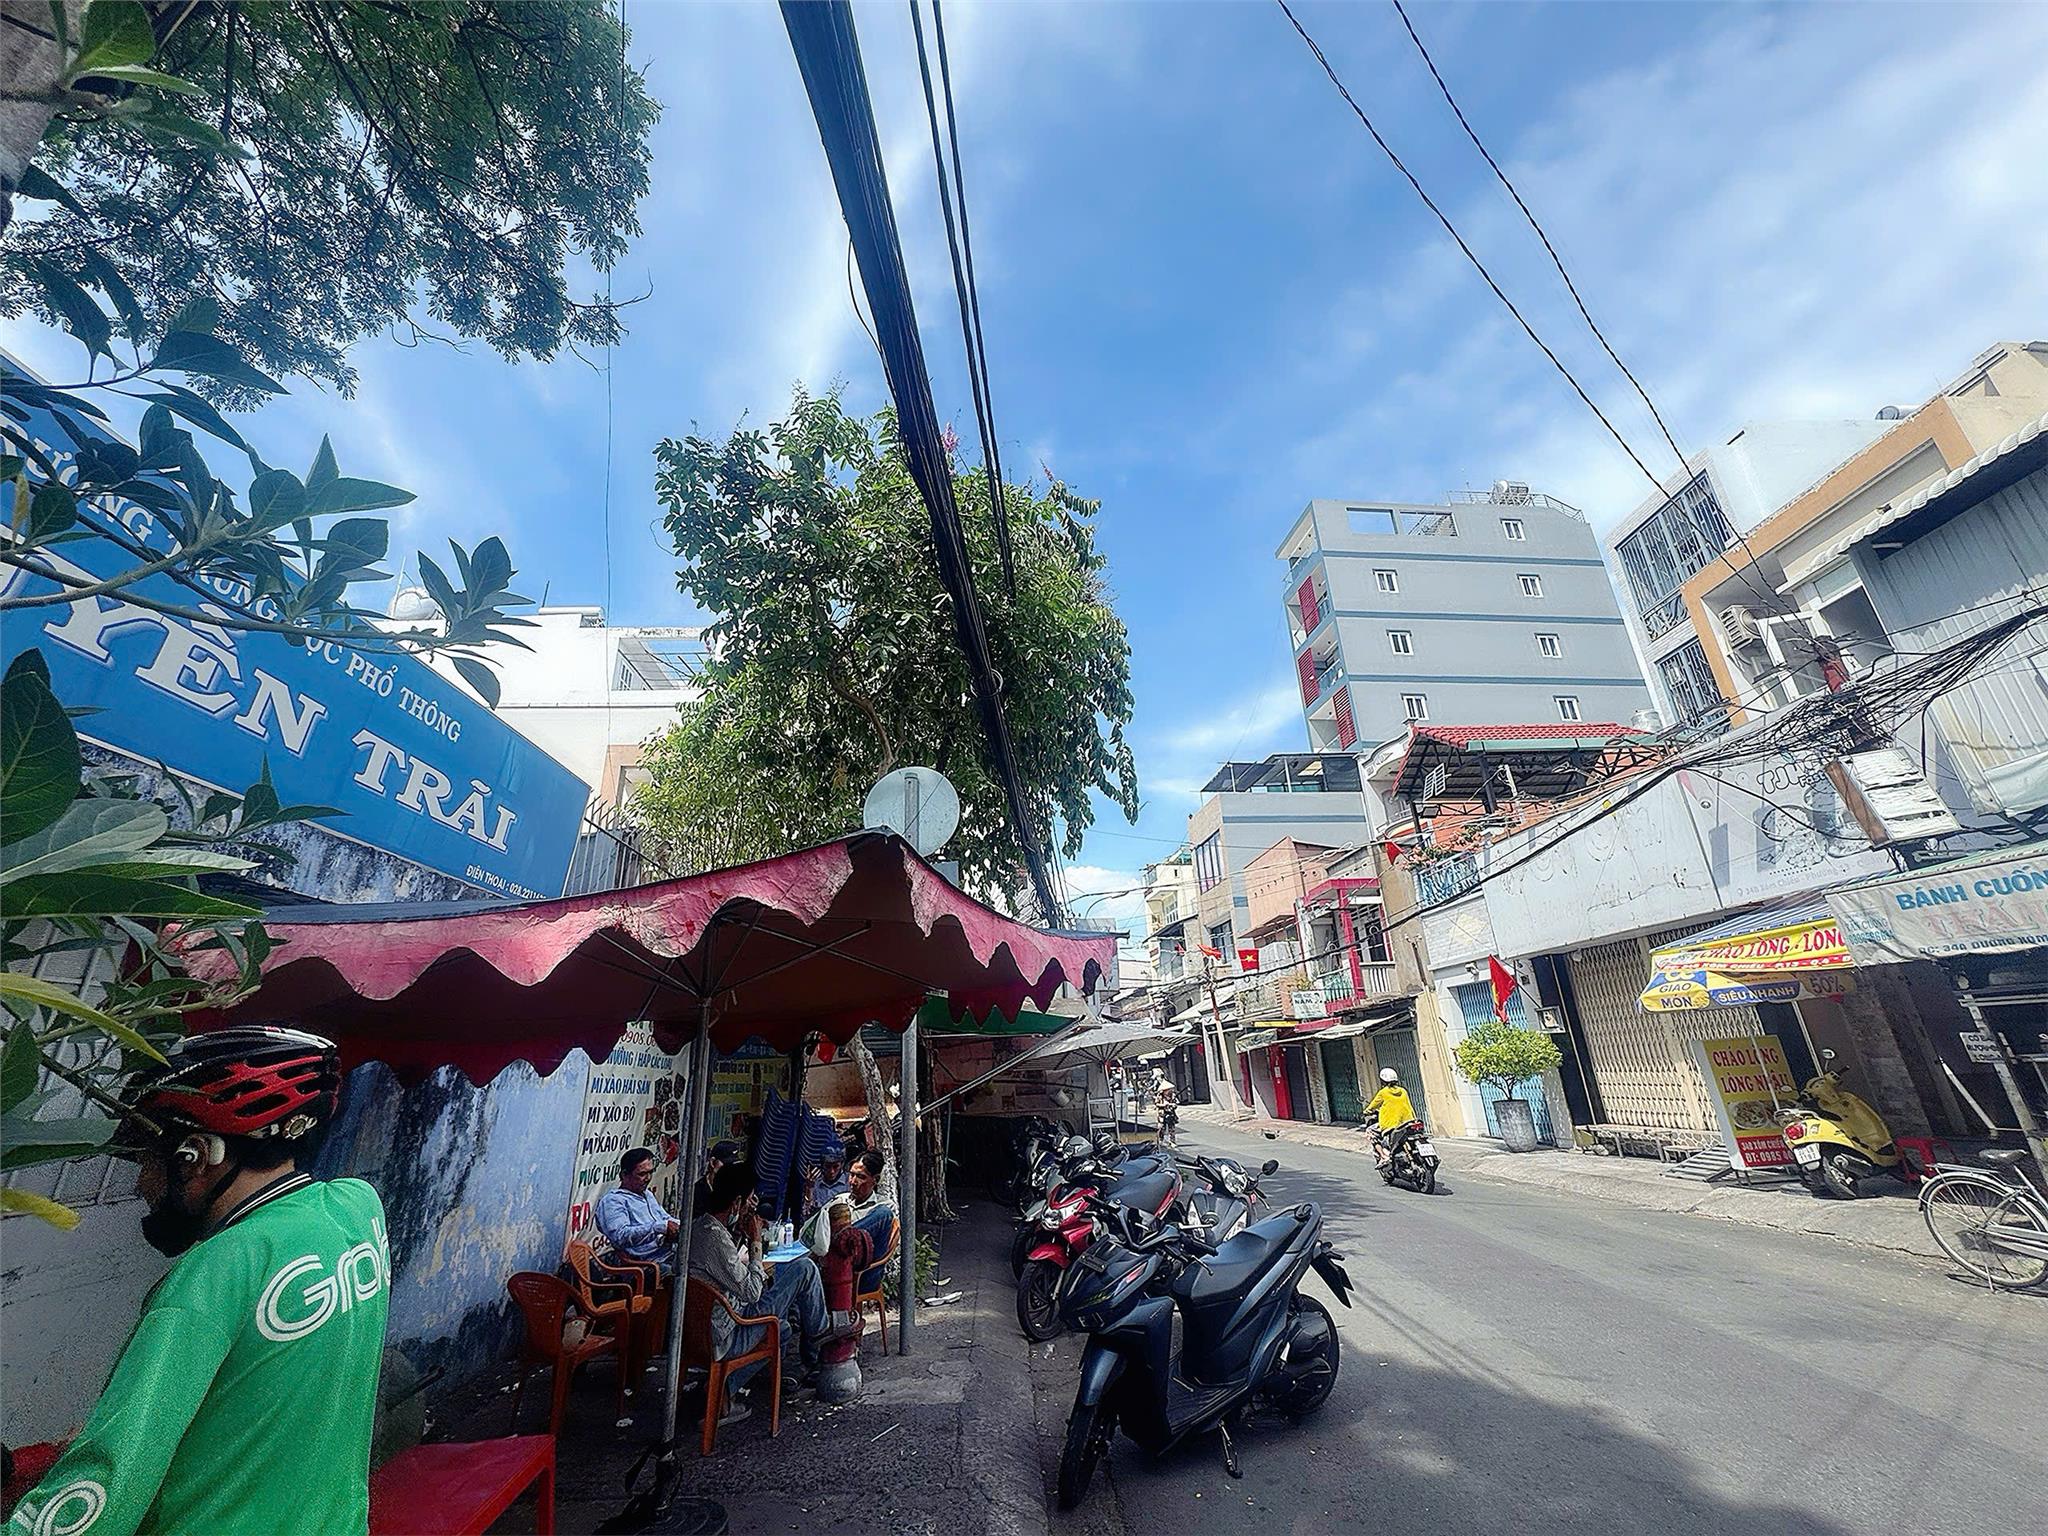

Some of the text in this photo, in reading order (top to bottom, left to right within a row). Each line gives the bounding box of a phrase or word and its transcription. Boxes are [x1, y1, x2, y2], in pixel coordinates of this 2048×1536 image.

[345, 652, 399, 698] PHỔ
[398, 686, 462, 744] THÔNG
[351, 728, 518, 855] TRÃI
[466, 864, 485, 882] ĐIỆN
[484, 871, 506, 892] THOẠI
[1895, 884, 1969, 911] BÁNH
[1744, 935, 1790, 959] LÒNG
[1659, 982, 1692, 993] GIAO
[1718, 985, 1796, 1003] SIÊU NHANH
[1660, 993, 1693, 1009] MÓN
[603, 1073, 622, 1094] XÀO
[1720, 1072, 1754, 1093] LÒNG
[601, 1102, 622, 1123] XÀO
[622, 1101, 636, 1122] BÒ
[596, 1130, 619, 1154] XÀO
